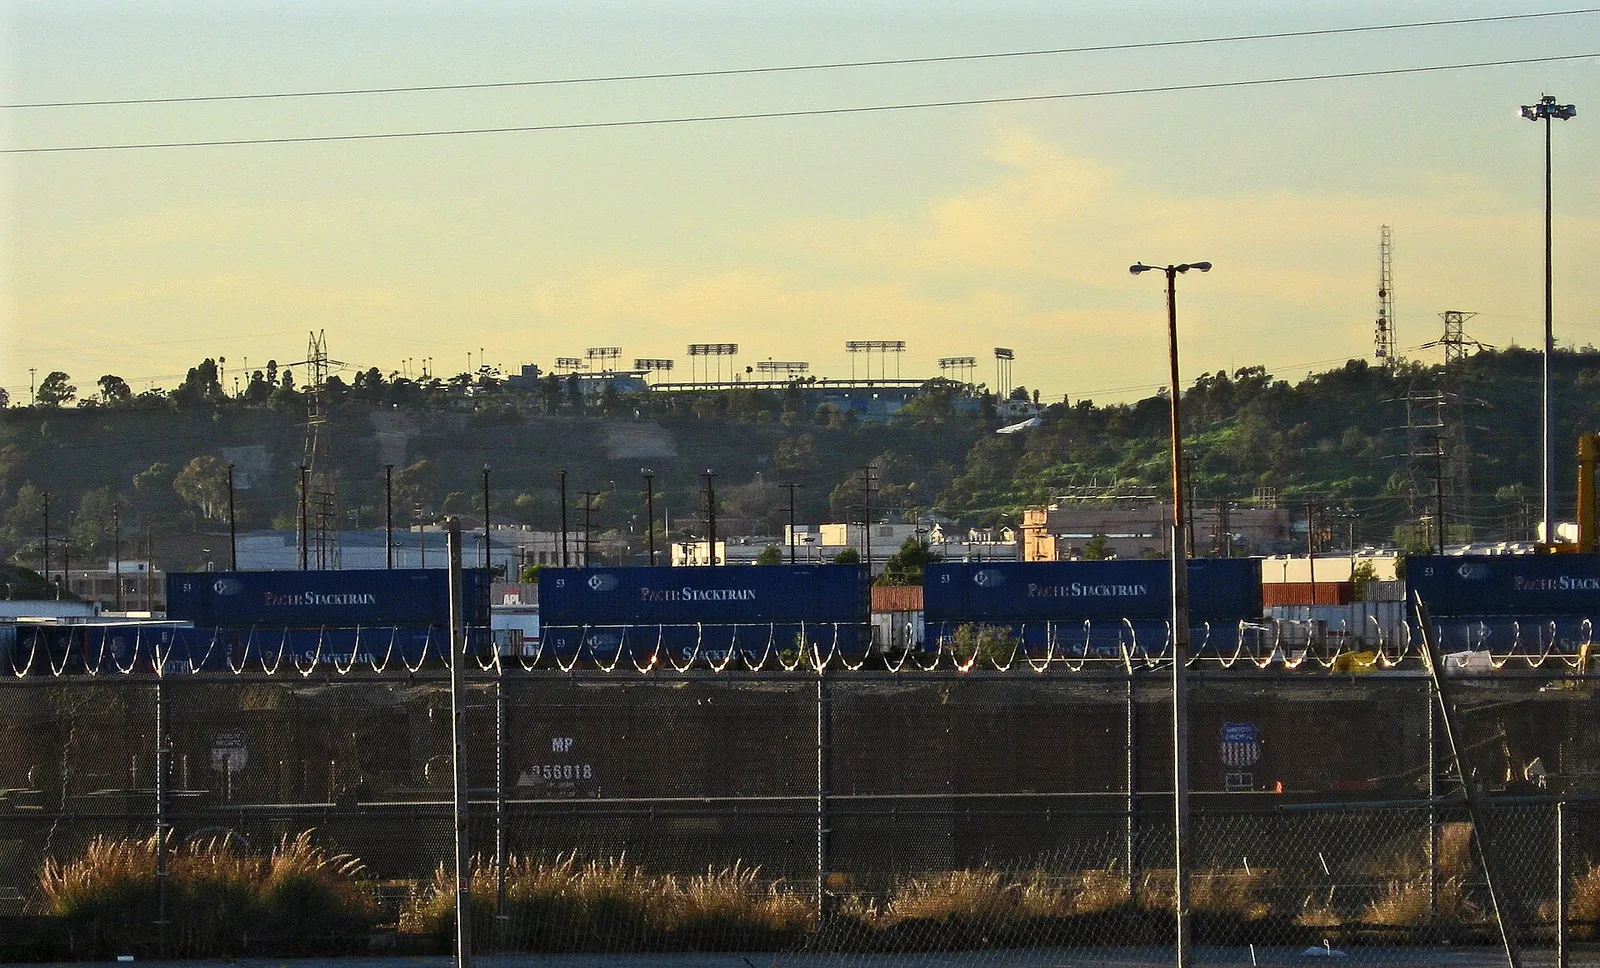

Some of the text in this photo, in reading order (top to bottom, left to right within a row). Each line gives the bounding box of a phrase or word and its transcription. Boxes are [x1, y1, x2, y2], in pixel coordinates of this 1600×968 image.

[1424, 567, 1434, 577] 53
[556, 579, 565, 588] 53
[940, 574, 951, 584] 53
[183, 583, 192, 592] 53
[1071, 582, 1148, 597] STACKTRAIN
[304, 591, 376, 605] STACKTRAIN
[682, 587, 756, 601] STACKTRAIN
[503, 594, 521, 605] APL
[556, 639, 566, 648] 53
[552, 737, 573, 752] MP
